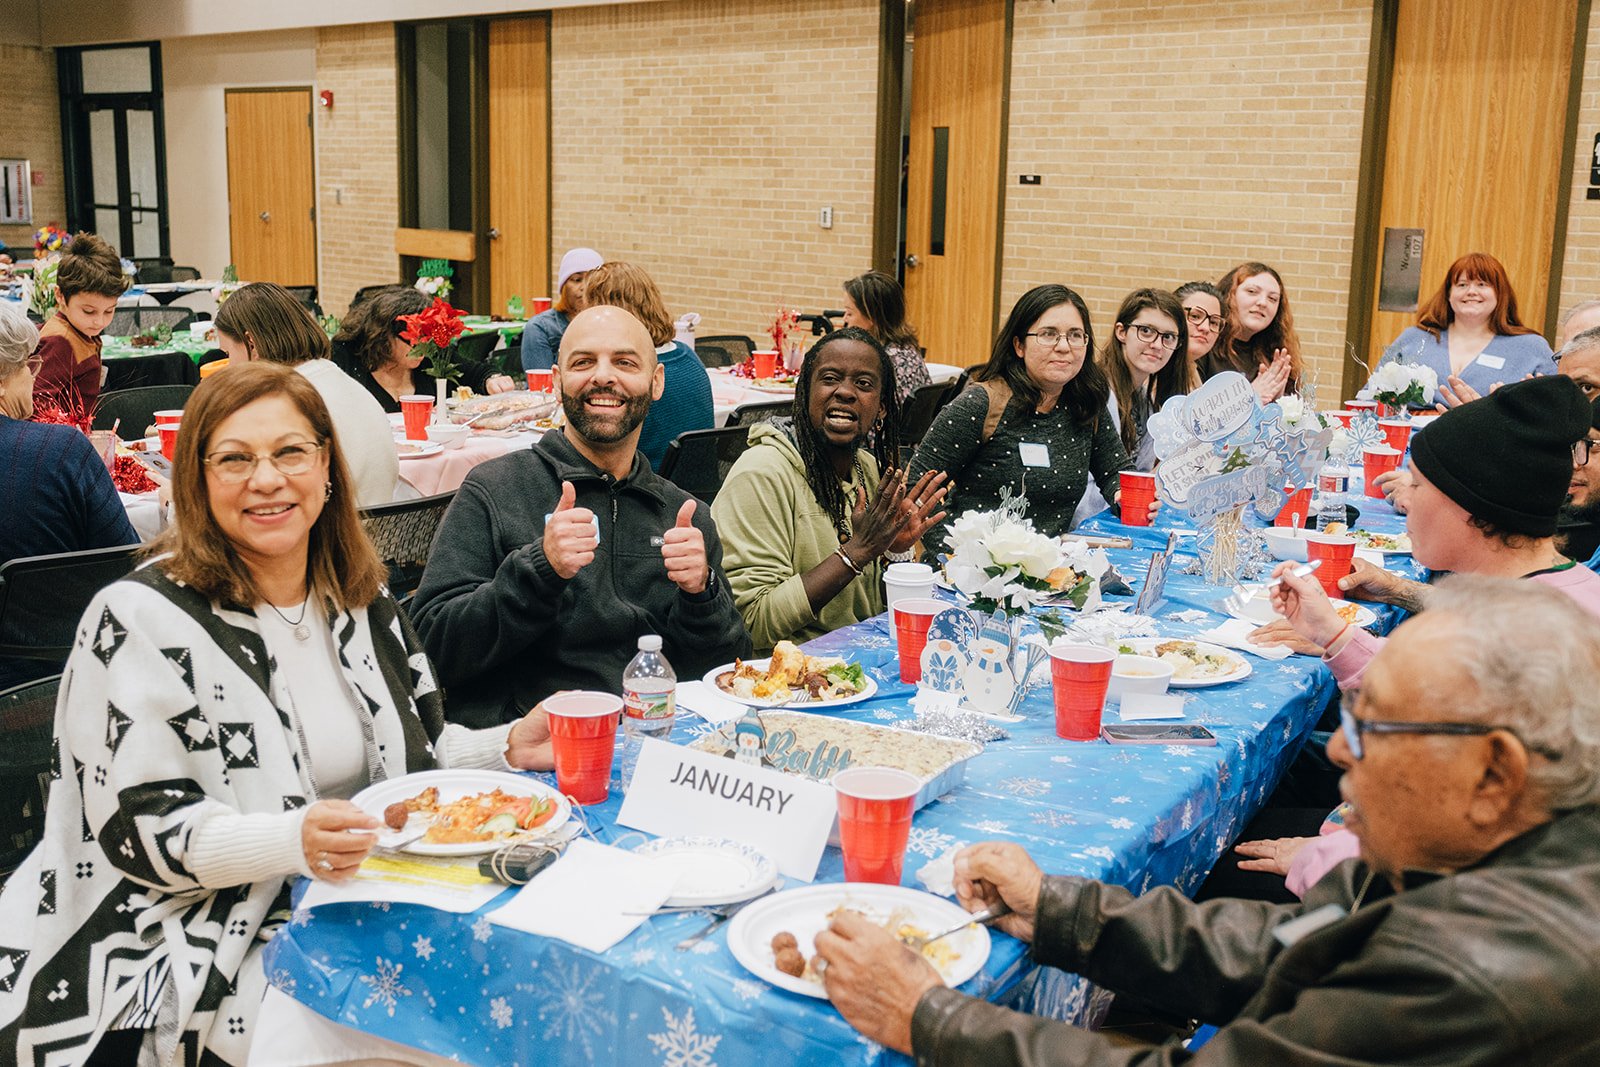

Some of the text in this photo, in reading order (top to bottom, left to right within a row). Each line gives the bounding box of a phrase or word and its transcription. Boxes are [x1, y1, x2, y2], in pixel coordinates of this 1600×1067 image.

[1412, 239, 1420, 255] 107
[1192, 379, 1247, 419] WARM IN
[766, 728, 855, 779] Baby
[670, 761, 794, 815] JANUARY
